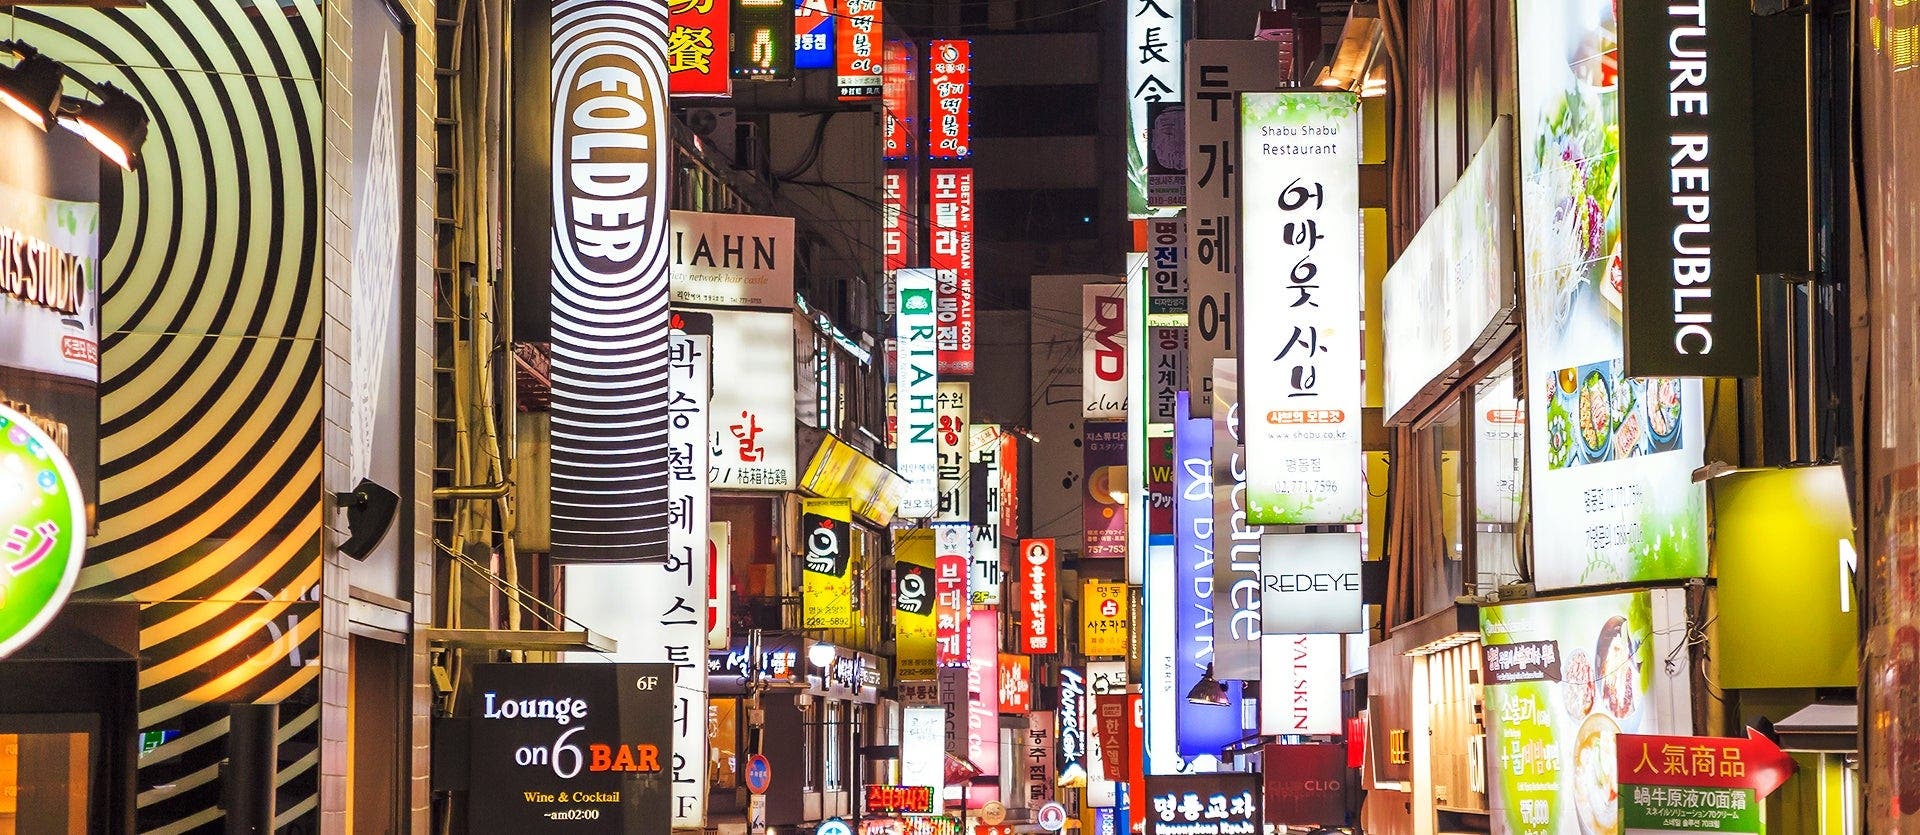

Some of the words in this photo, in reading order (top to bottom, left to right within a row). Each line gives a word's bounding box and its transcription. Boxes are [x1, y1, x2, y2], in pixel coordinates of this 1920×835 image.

[667, 0, 715, 75] 餐
[1262, 125, 1297, 137] Shabu
[1302, 124, 1337, 136] Shabu
[570, 65, 649, 263] FOLDER
[1263, 143, 1337, 156] Restaurant
[935, 174, 959, 256] 포탈라
[960, 174, 971, 222] TIBETAN
[1196, 65, 1233, 351] 두가헤어
[1667, 135, 1713, 356] REPUBLIC
[961, 322, 971, 350] FOOD
[1095, 295, 1125, 382] DVD
[910, 325, 934, 444] RIAHN
[730, 410, 763, 462] 닭
[972, 590, 990, 603] 2F
[1263, 573, 1359, 593] REDEYE
[937, 563, 961, 656] 부대찌개
[636, 675, 659, 691] 6F
[905, 685, 938, 699] 부동산
[484, 691, 588, 725] Lounge
[1293, 680, 1308, 731] SKIN
[515, 746, 548, 766] on
[551, 726, 586, 779] 6
[589, 743, 661, 773] BAR
[1633, 742, 1745, 778] 人氣商品
[524, 791, 553, 803] Wine
[558, 792, 568, 803] &
[572, 791, 620, 803] Cocktail
[1304, 780, 1341, 791] CLIO
[1634, 786, 1746, 810] 蝸牛原液70面霜
[543, 809, 600, 823] ~am02:00
[1153, 790, 1257, 822] 명동교자
